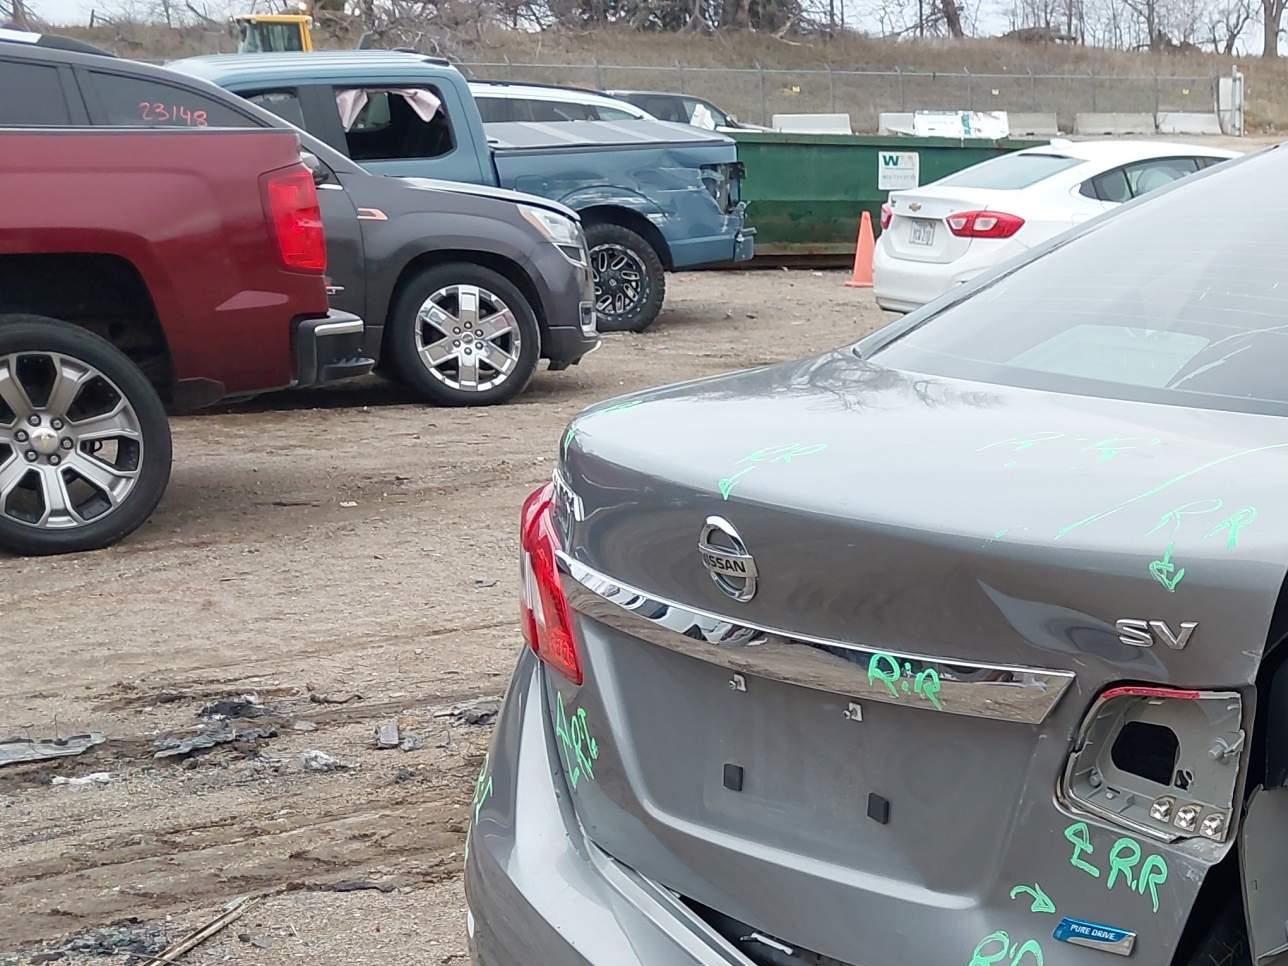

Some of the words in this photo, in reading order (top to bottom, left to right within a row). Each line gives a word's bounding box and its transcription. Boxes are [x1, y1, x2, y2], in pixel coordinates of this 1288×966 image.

[139, 102, 208, 129] 23148
[1115, 618, 1199, 650] SV
[1070, 925, 1091, 935] PURE
[1091, 929, 1116, 940] DRIVE
